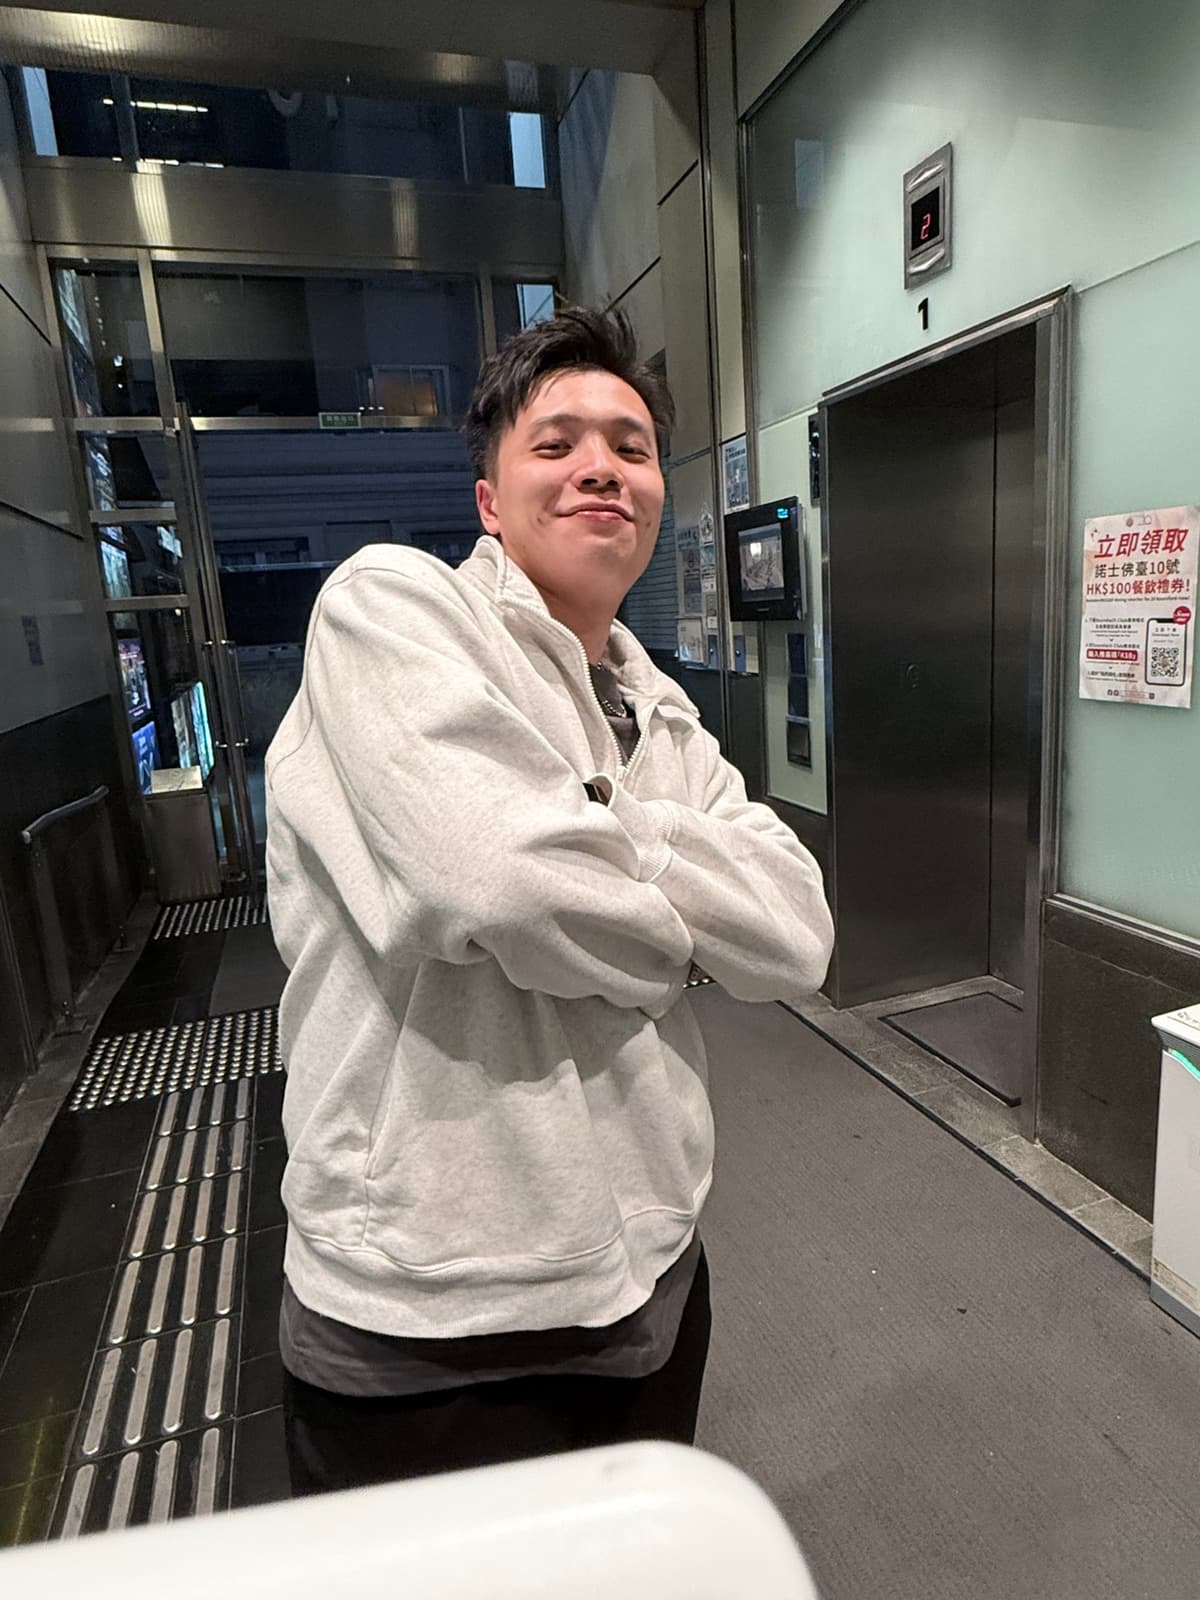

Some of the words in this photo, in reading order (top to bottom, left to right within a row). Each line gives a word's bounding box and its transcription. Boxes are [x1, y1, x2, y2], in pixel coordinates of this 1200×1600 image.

[920, 213, 931, 240] 2
[917, 297, 929, 331] 1
[1094, 528, 1189, 558] 立即領取
[1095, 558, 1180, 578] 諾士佛臺10號
